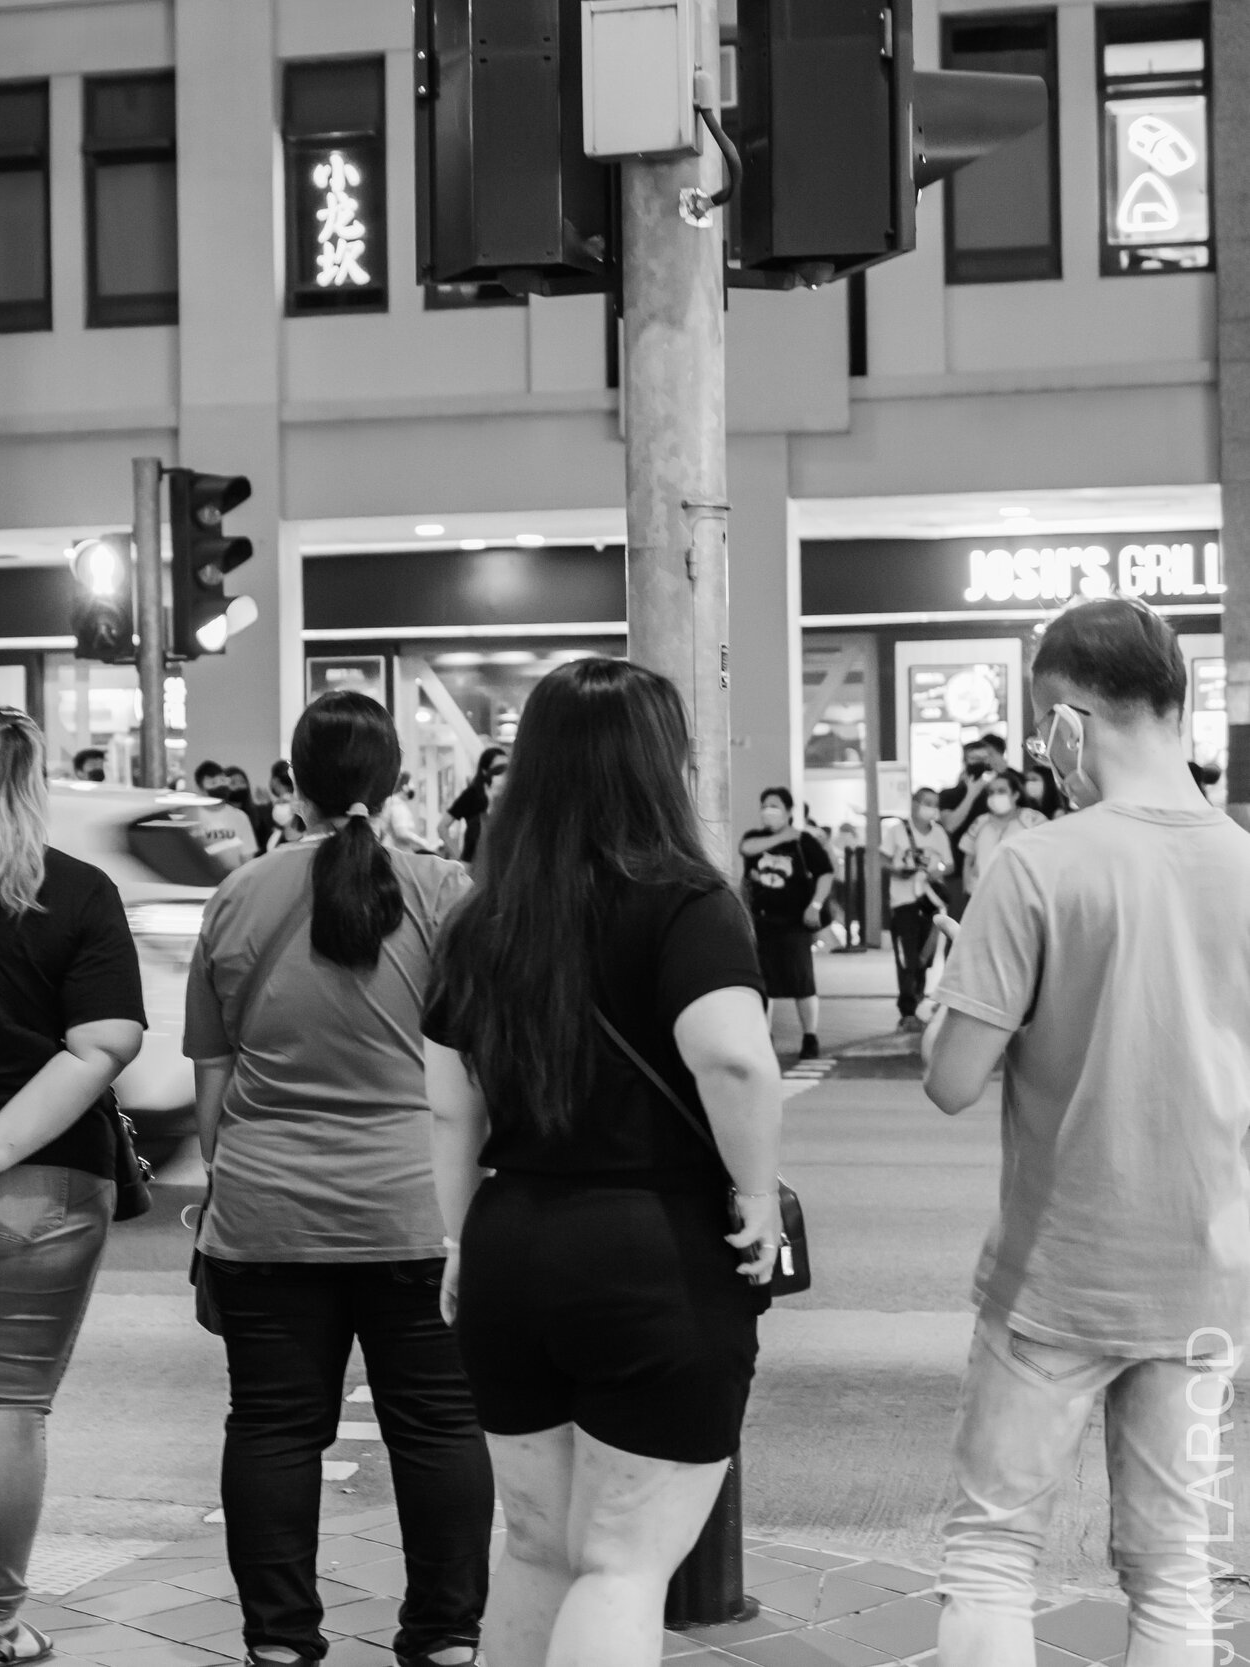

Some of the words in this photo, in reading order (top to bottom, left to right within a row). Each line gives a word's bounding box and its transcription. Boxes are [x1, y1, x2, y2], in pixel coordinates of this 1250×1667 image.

[313, 151, 371, 287] 小龙坎
[964, 546, 1110, 601] JOSH'S
[1118, 543, 1227, 597] GRILL
